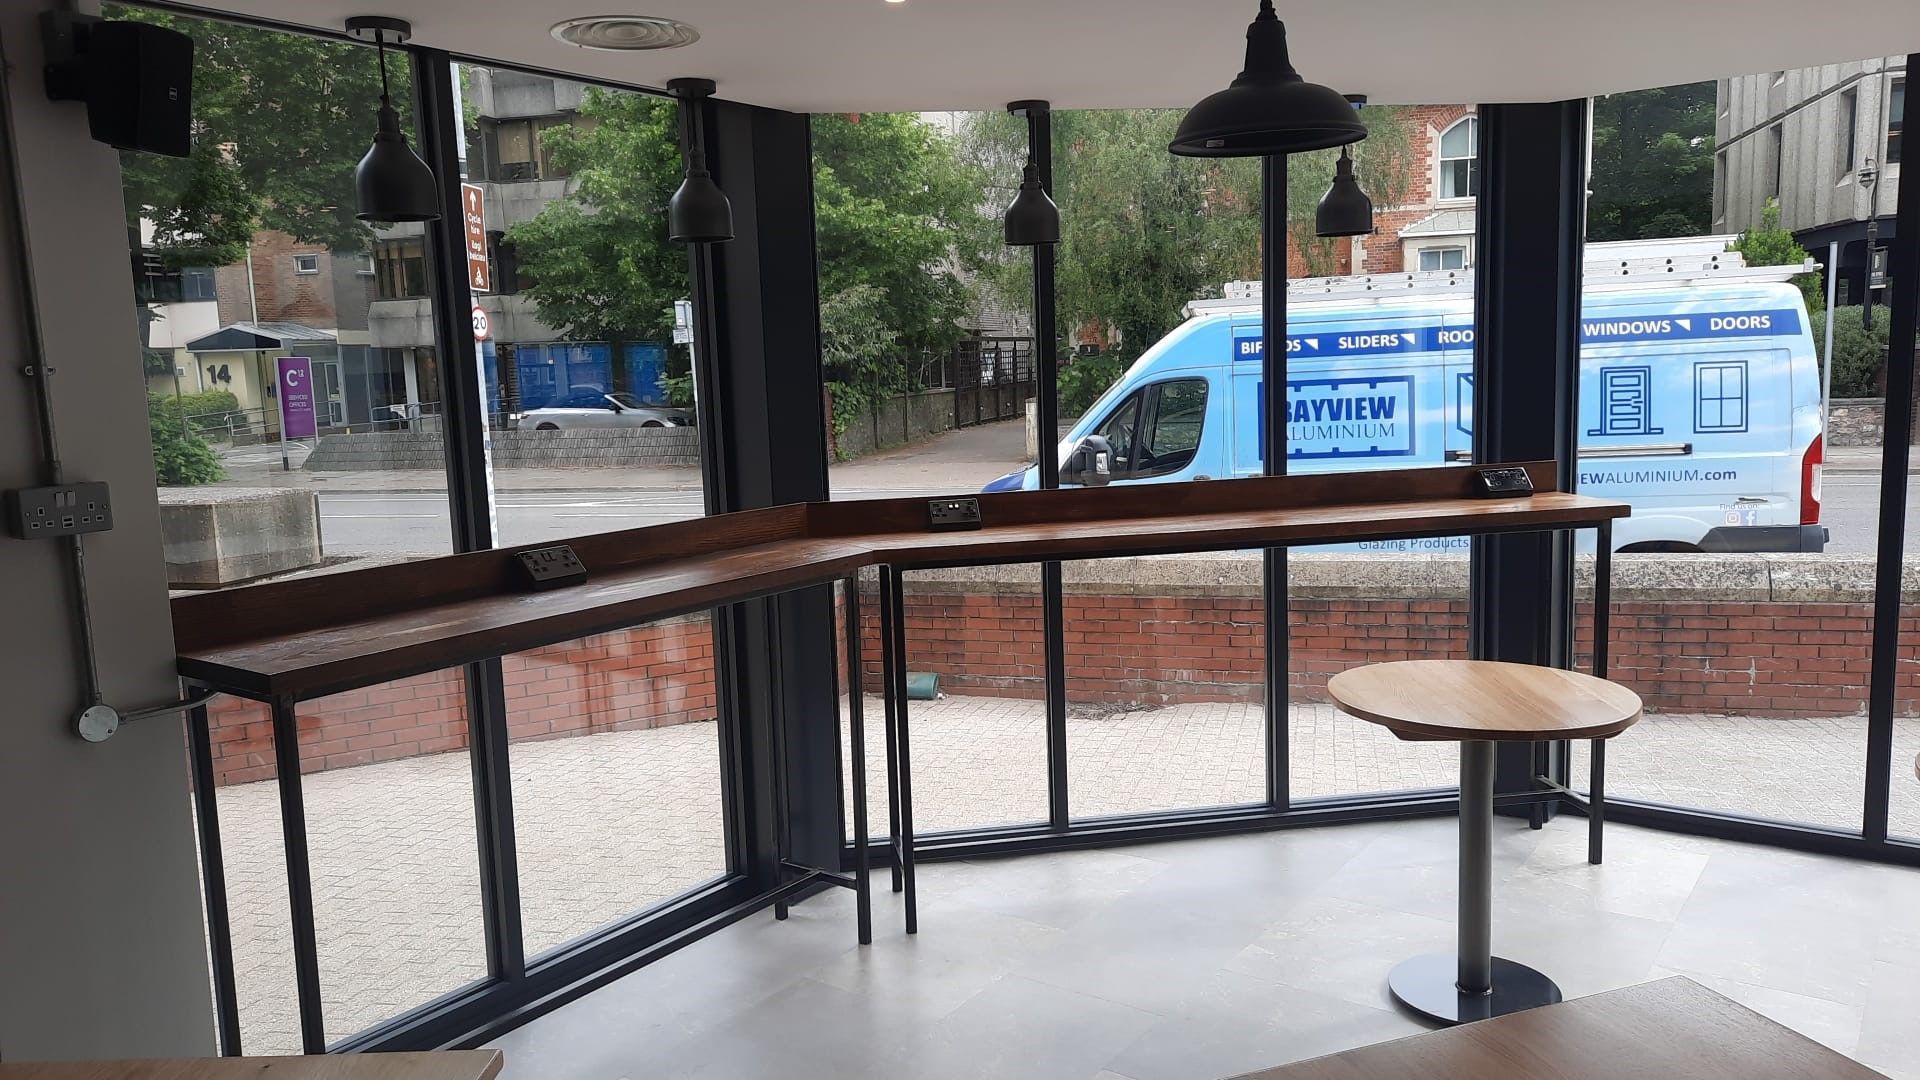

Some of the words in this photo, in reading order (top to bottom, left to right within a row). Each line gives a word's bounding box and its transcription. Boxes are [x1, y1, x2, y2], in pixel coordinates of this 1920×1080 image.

[467, 212, 482, 225] Cycle
[473, 316, 487, 330] 20
[1241, 338, 1302, 355] BIFDS
[1338, 333, 1399, 350] SLIDERS
[1438, 330, 1475, 344] ROO
[1583, 319, 1672, 336] WINDOWS
[1710, 315, 1771, 331] DOORS
[206, 364, 232, 385] 14
[1287, 423, 1395, 441] LUMINIUM
[1358, 540, 1406, 552] Glazing
[1410, 537, 1470, 549] Products
